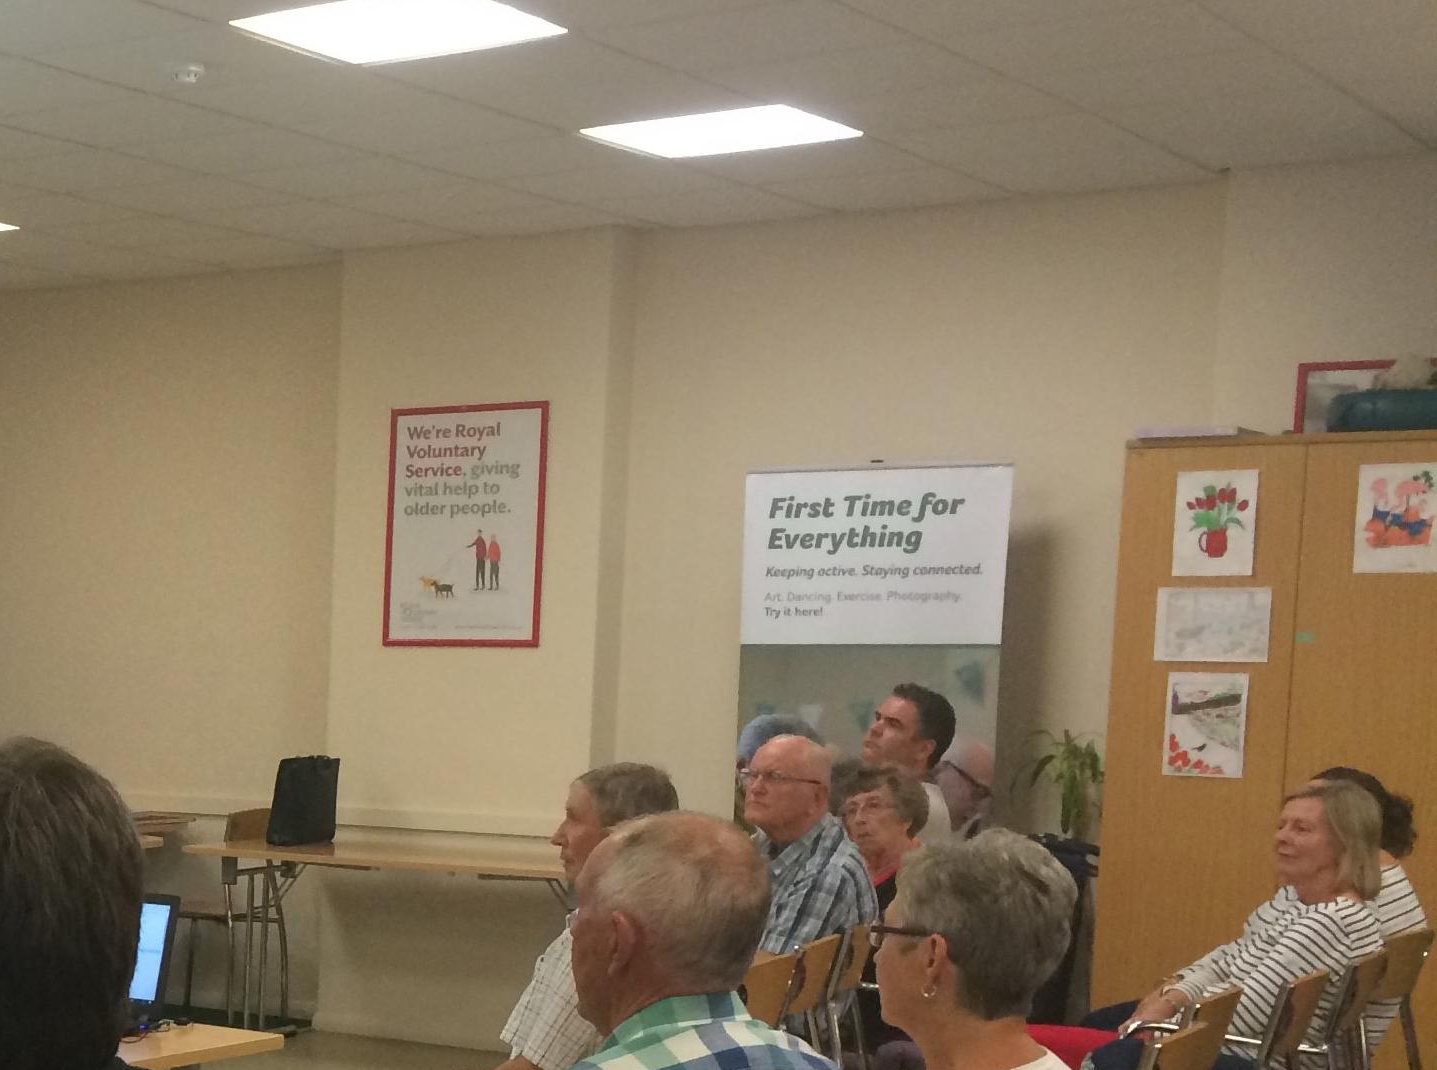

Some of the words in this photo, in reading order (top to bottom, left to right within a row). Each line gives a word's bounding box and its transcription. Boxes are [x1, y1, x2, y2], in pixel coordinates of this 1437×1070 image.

[407, 425, 451, 440] We're
[455, 422, 501, 440] Royal
[406, 445, 486, 460] Voluntary
[470, 461, 520, 480] giving
[404, 482, 438, 497] vital
[443, 482, 479, 499] help
[483, 481, 500, 495] to
[404, 502, 446, 516] older
[450, 500, 511, 518] people.
[769, 495, 835, 519] First
[843, 493, 912, 518] Time
[912, 492, 965, 522] for
[767, 524, 923, 555] Everything
[765, 566, 814, 580] Keeping
[862, 564, 910, 579] Staying
[913, 563, 983, 577] connected.
[764, 607, 781, 619] Try
[783, 606, 792, 617] it
[795, 606, 823, 617] here!
